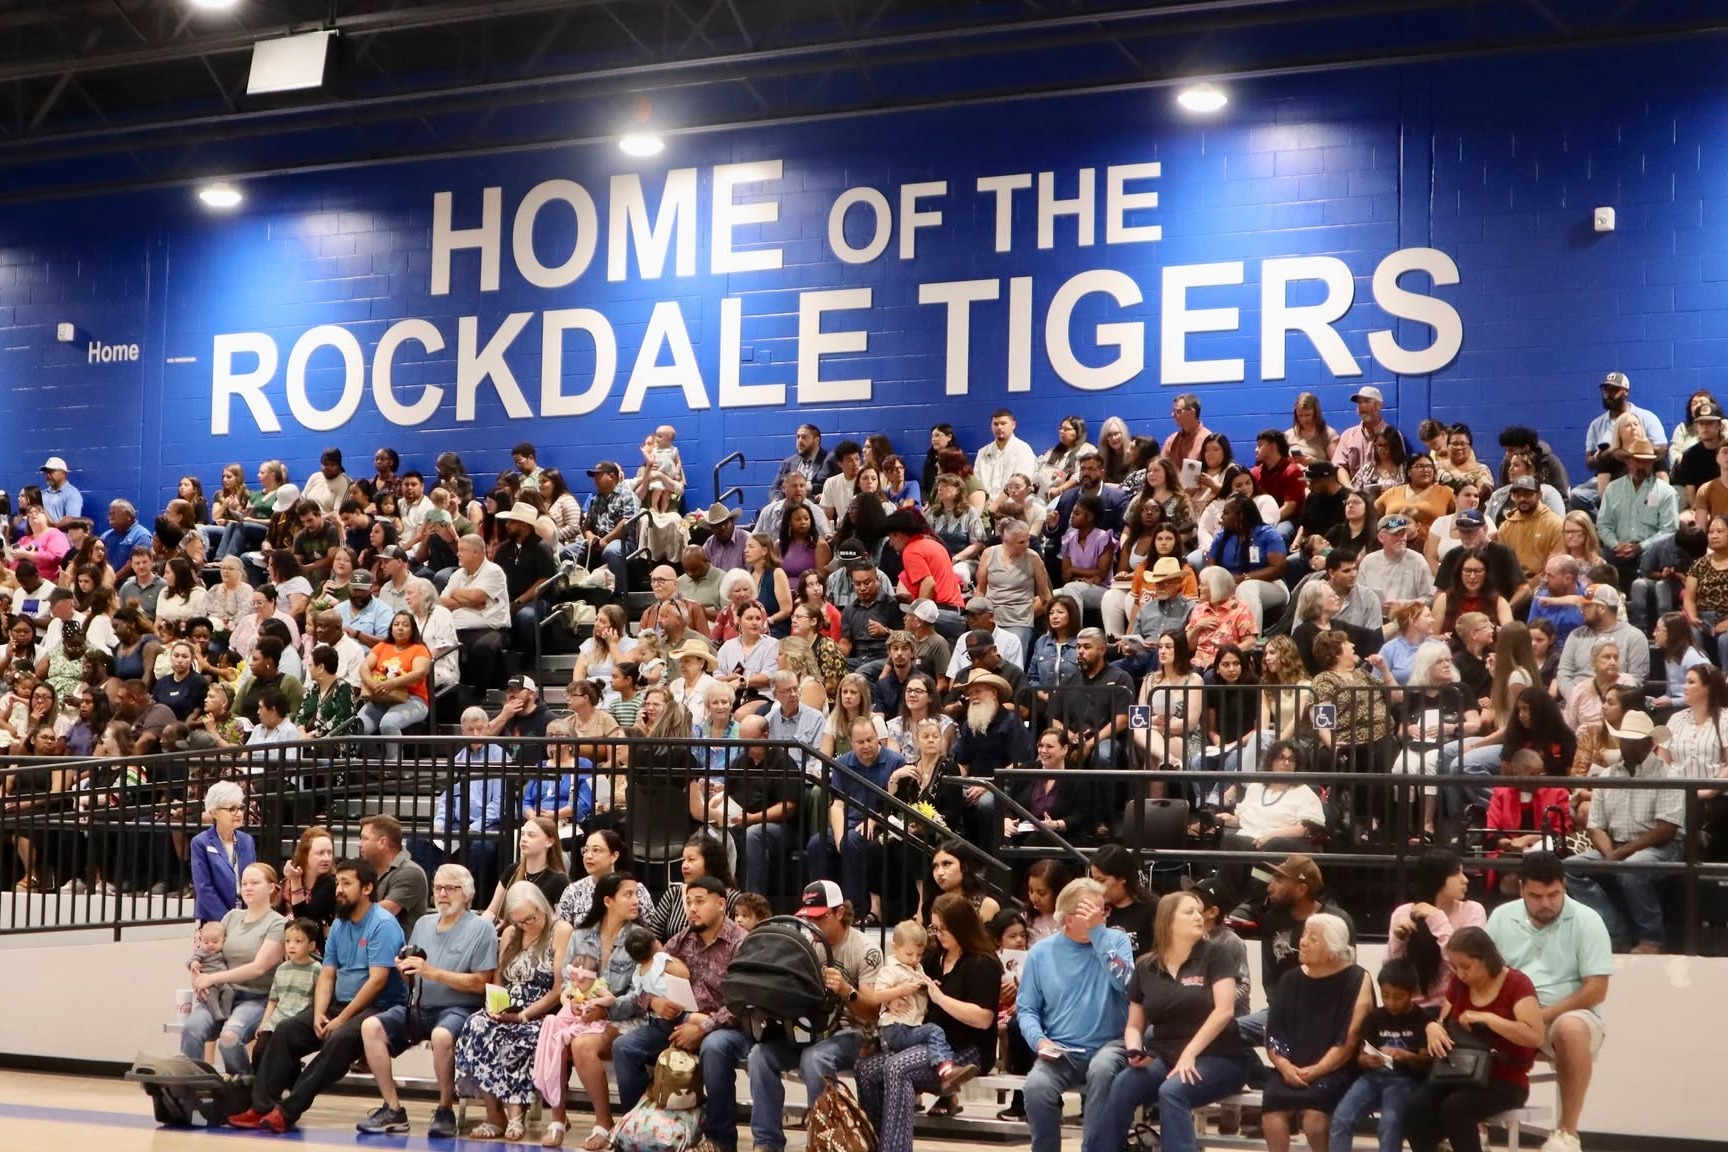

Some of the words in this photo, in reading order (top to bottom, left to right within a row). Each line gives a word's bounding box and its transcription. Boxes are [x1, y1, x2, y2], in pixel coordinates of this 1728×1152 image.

[430, 159, 786, 297] HOME
[828, 181, 948, 265] OF
[977, 161, 1163, 252] THE
[87, 340, 140, 364] Home
[210, 287, 873, 435] ROCKDALE
[918, 248, 1464, 395] TIGERS
